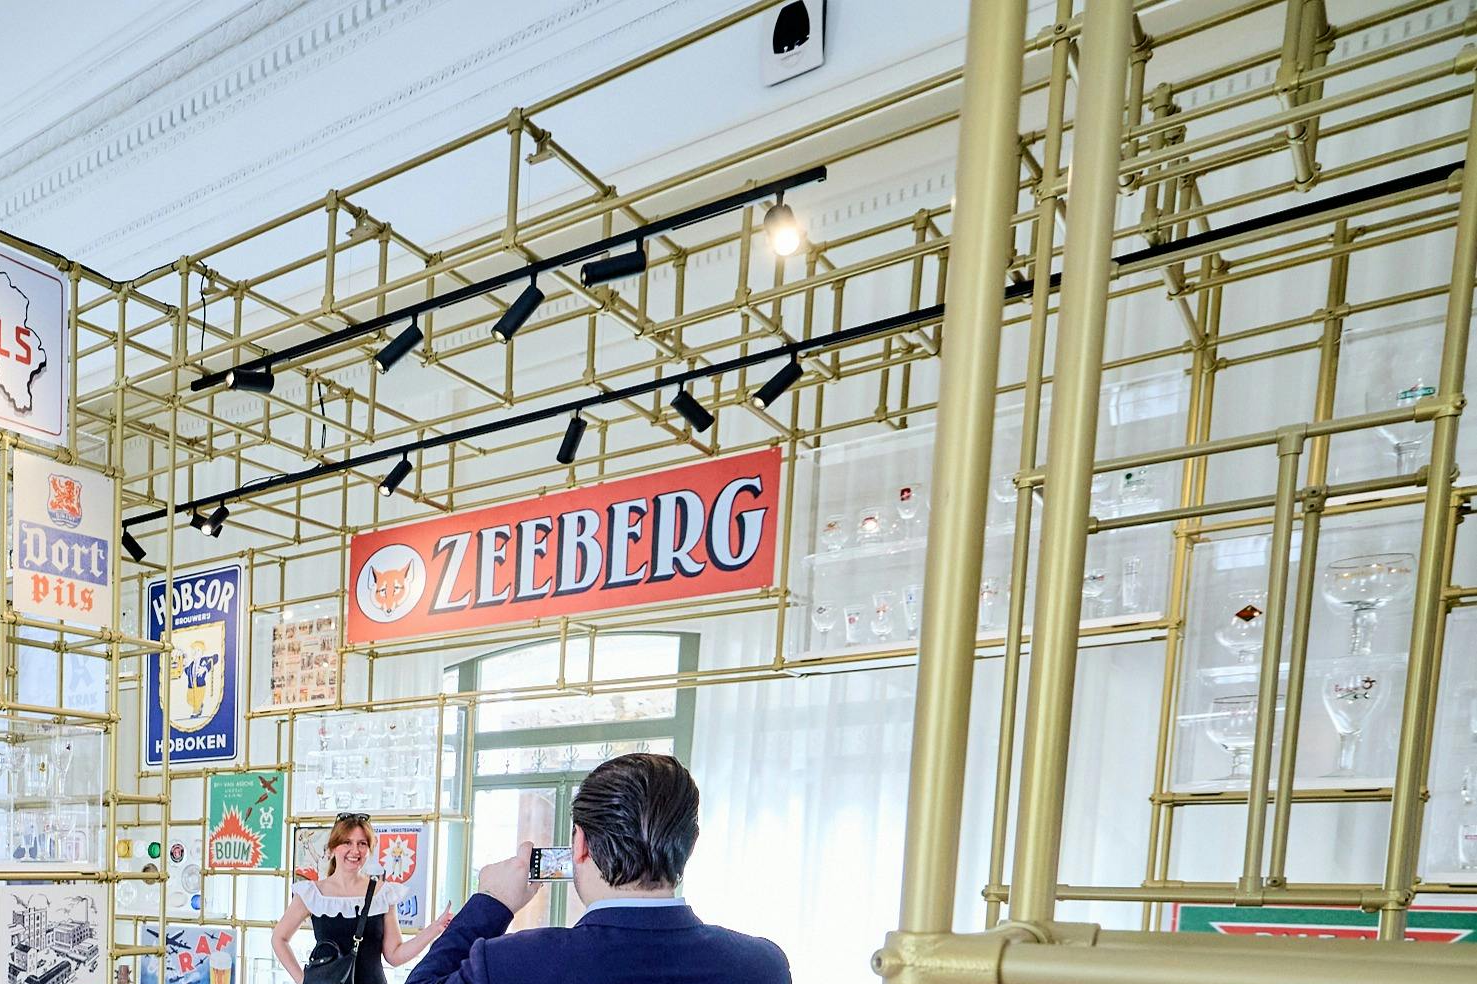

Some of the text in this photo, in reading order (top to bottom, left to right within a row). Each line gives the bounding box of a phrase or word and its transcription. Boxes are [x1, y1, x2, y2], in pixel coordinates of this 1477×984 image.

[23, 523, 106, 579] Dort
[429, 475, 767, 615] ZEEBERG
[153, 578, 235, 626] HOBSOR
[155, 734, 227, 754] HOBOKEN
[215, 841, 251, 861] BOUM
